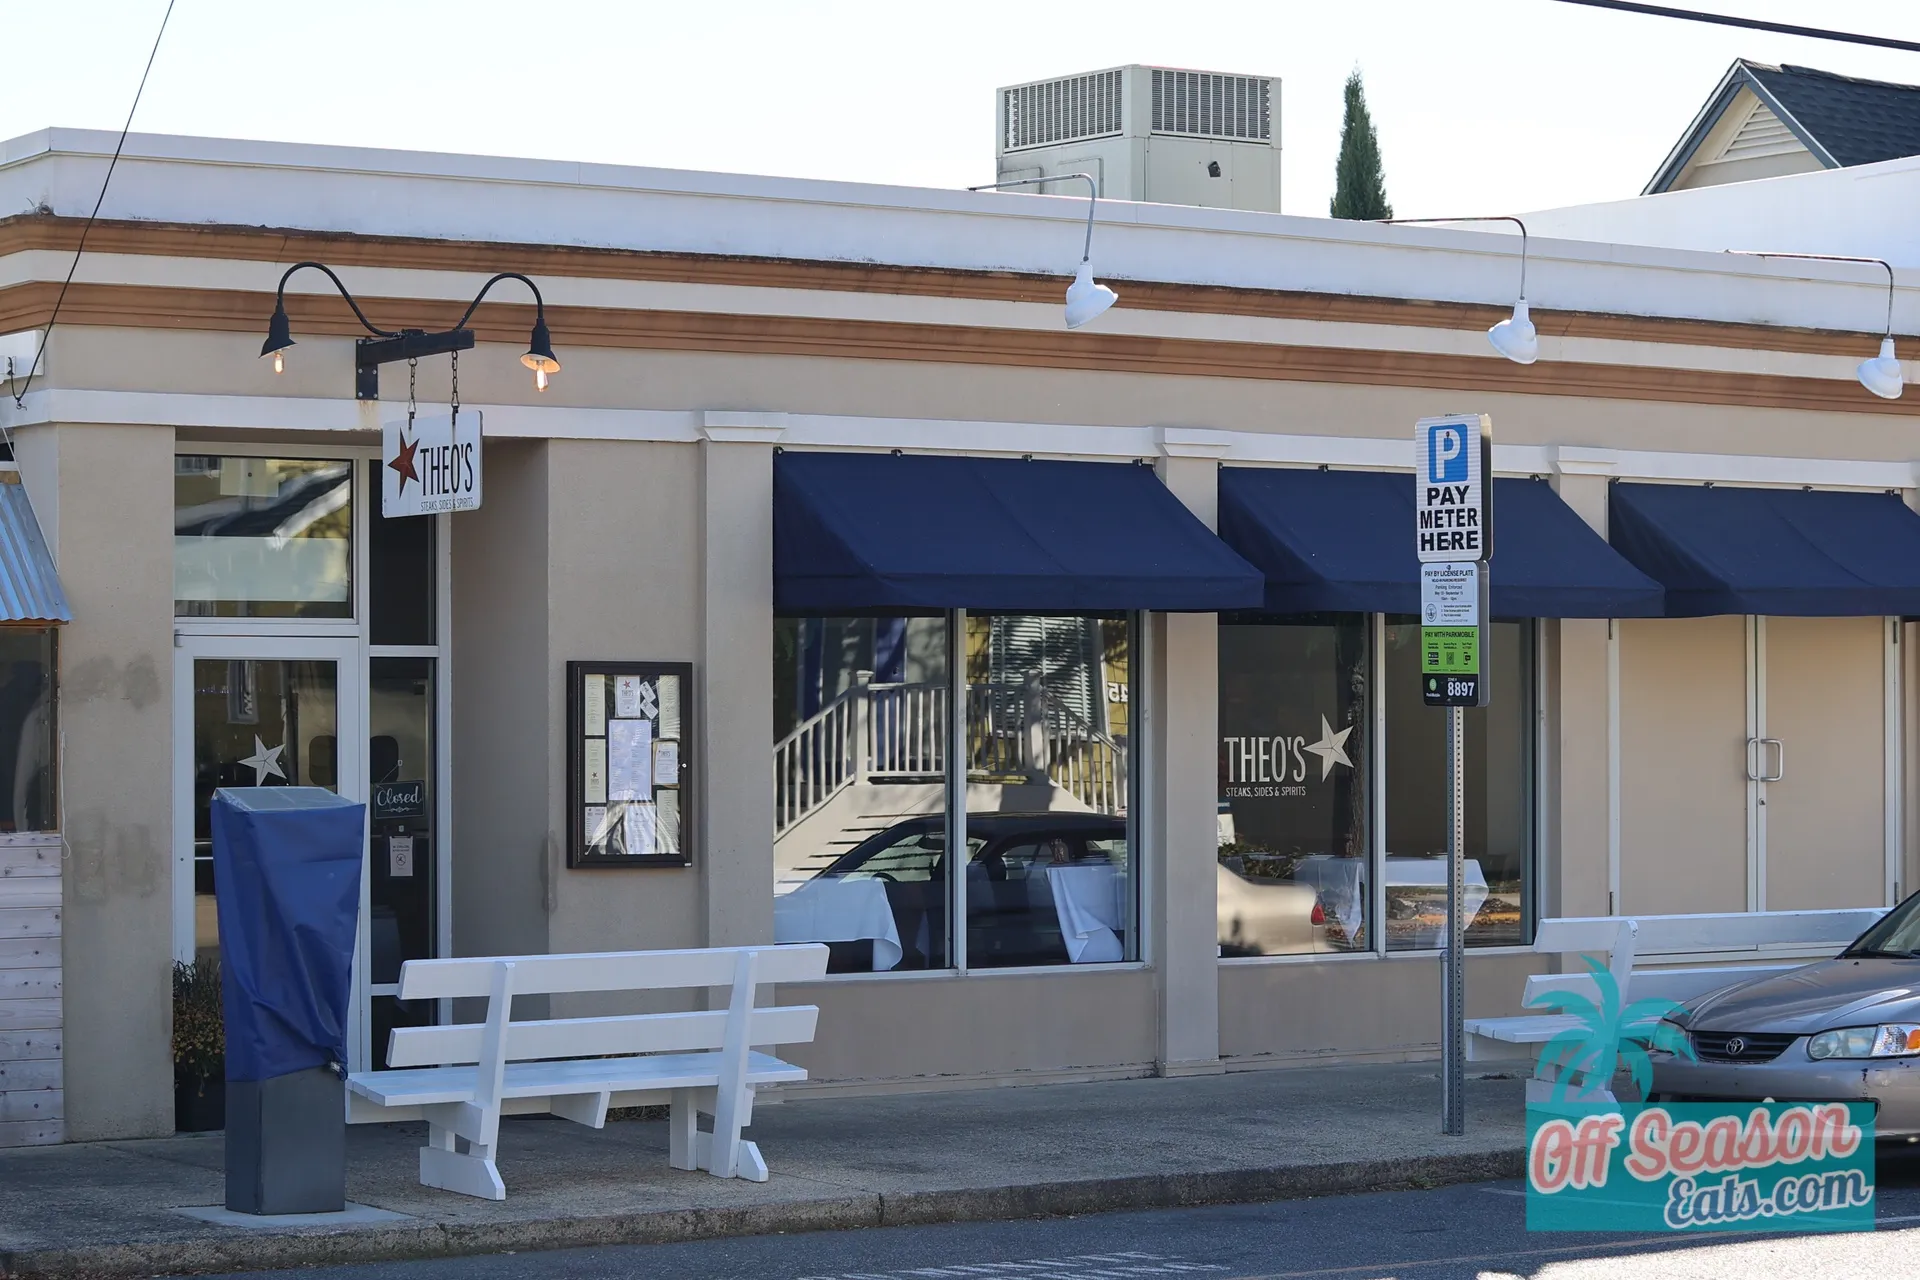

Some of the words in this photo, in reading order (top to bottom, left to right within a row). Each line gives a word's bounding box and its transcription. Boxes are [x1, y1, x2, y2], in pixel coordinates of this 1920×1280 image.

[1435, 428, 1461, 479] P
[420, 442, 473, 496] THEO'S
[420, 500, 438, 511] STEAKS,
[439, 499, 452, 510] SIDES
[457, 497, 474, 508] SPIRITS
[1426, 485, 1470, 506] PAY
[1420, 507, 1478, 529] METER
[1420, 530, 1479, 551] HERE
[1440, 569, 1459, 577] LICENSE
[1459, 569, 1474, 577] PLATE
[1447, 681, 1475, 697] 8897
[1223, 735, 1306, 783] THEO'S
[376, 785, 422, 807] Closed
[1225, 787, 1253, 798] STEAKS,
[1254, 786, 1274, 797] SIDES
[1274, 786, 1280, 797] &
[1281, 785, 1306, 796] SPIRITS
